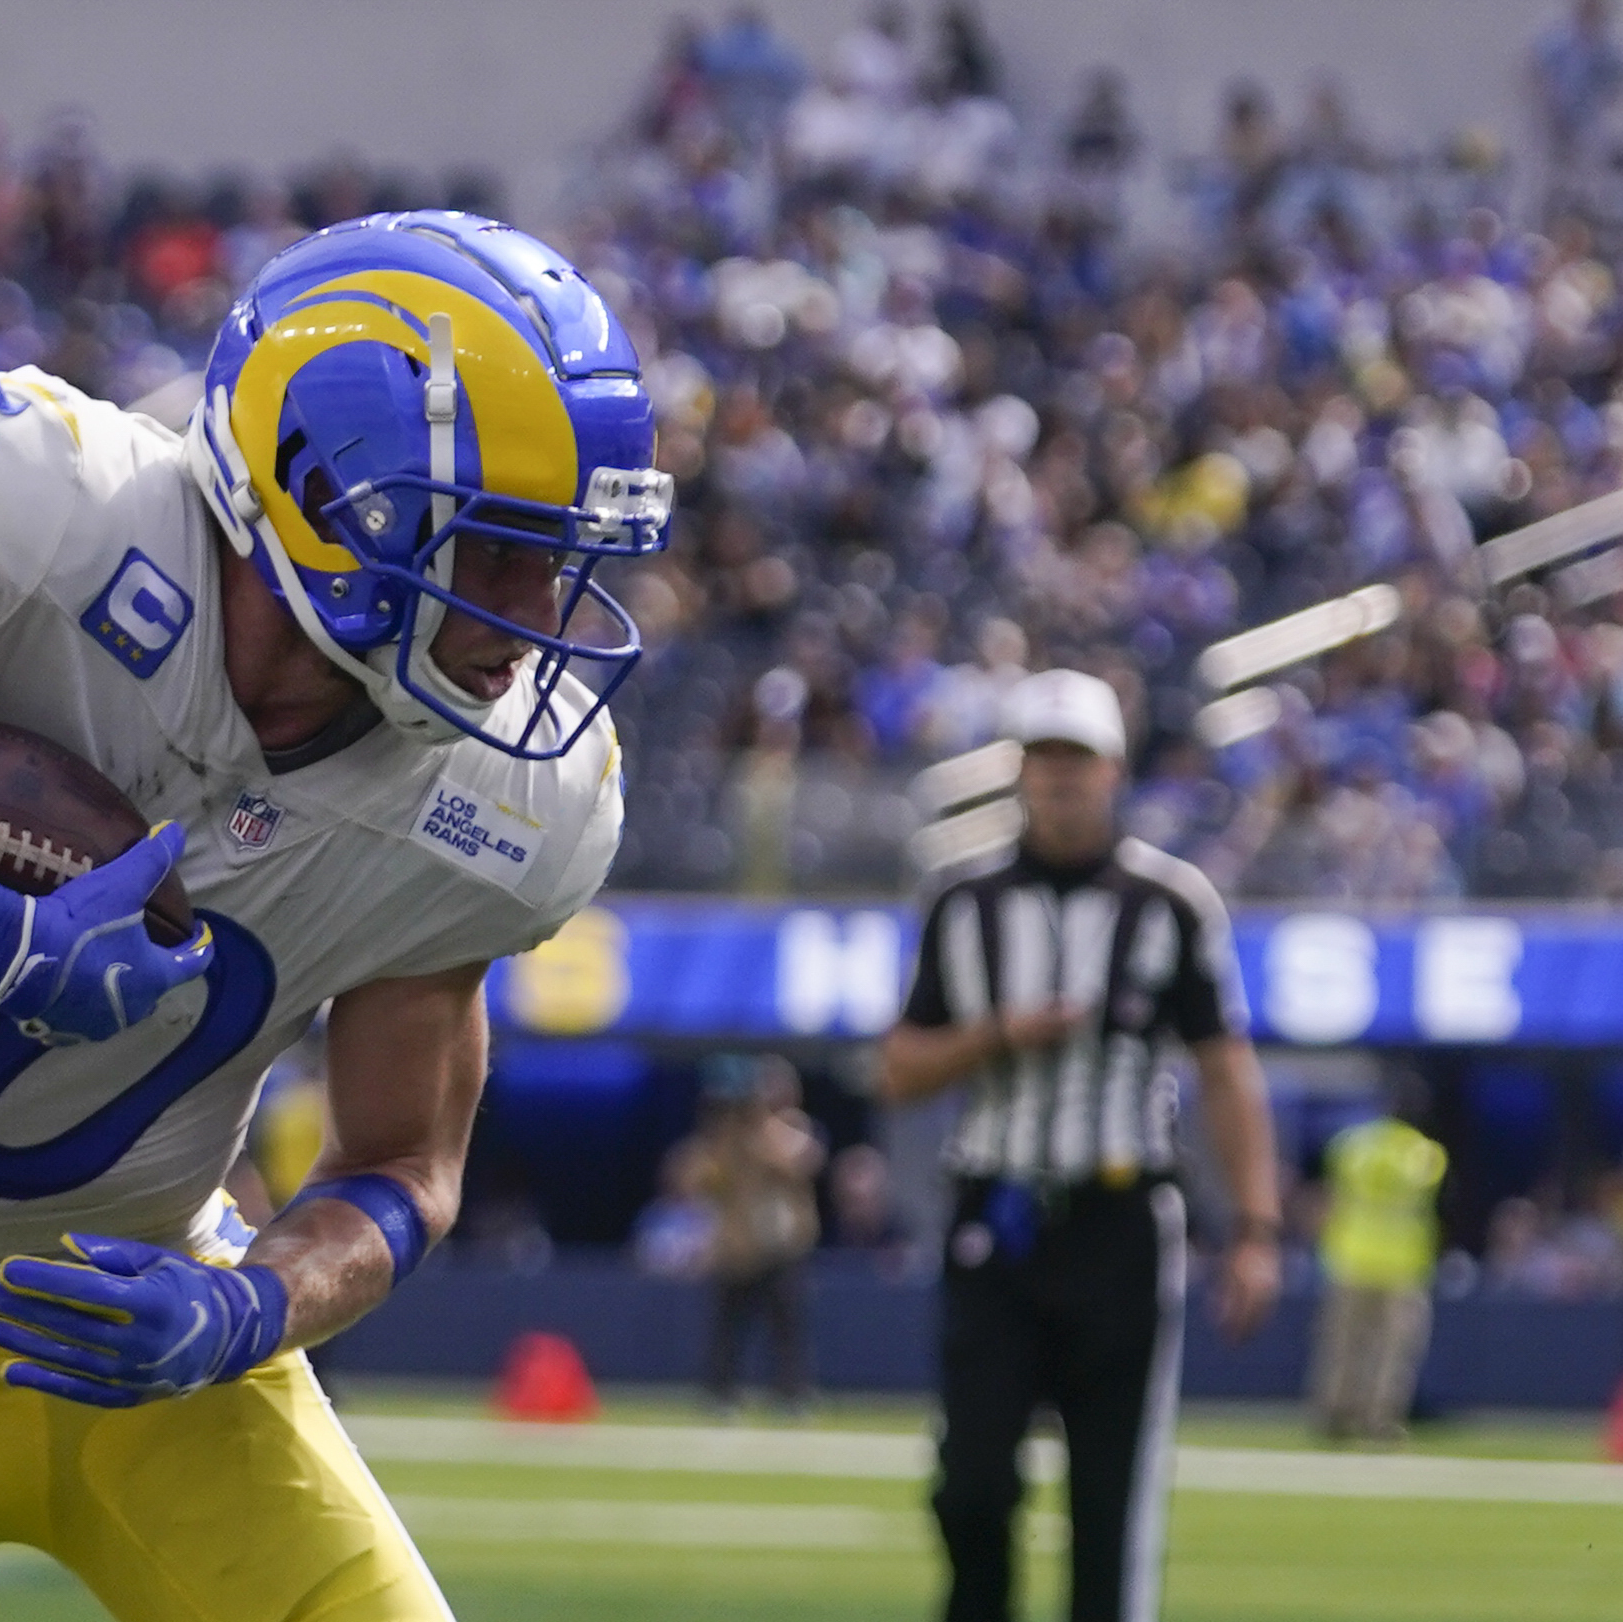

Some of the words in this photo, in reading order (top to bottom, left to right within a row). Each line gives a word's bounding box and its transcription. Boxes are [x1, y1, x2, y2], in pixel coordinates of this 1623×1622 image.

[108, 560, 185, 650] C
[437, 789, 478, 819] LOS
[231, 811, 265, 842] NFL
[423, 820, 480, 857] RAMS
[430, 806, 527, 863] ANGELES
